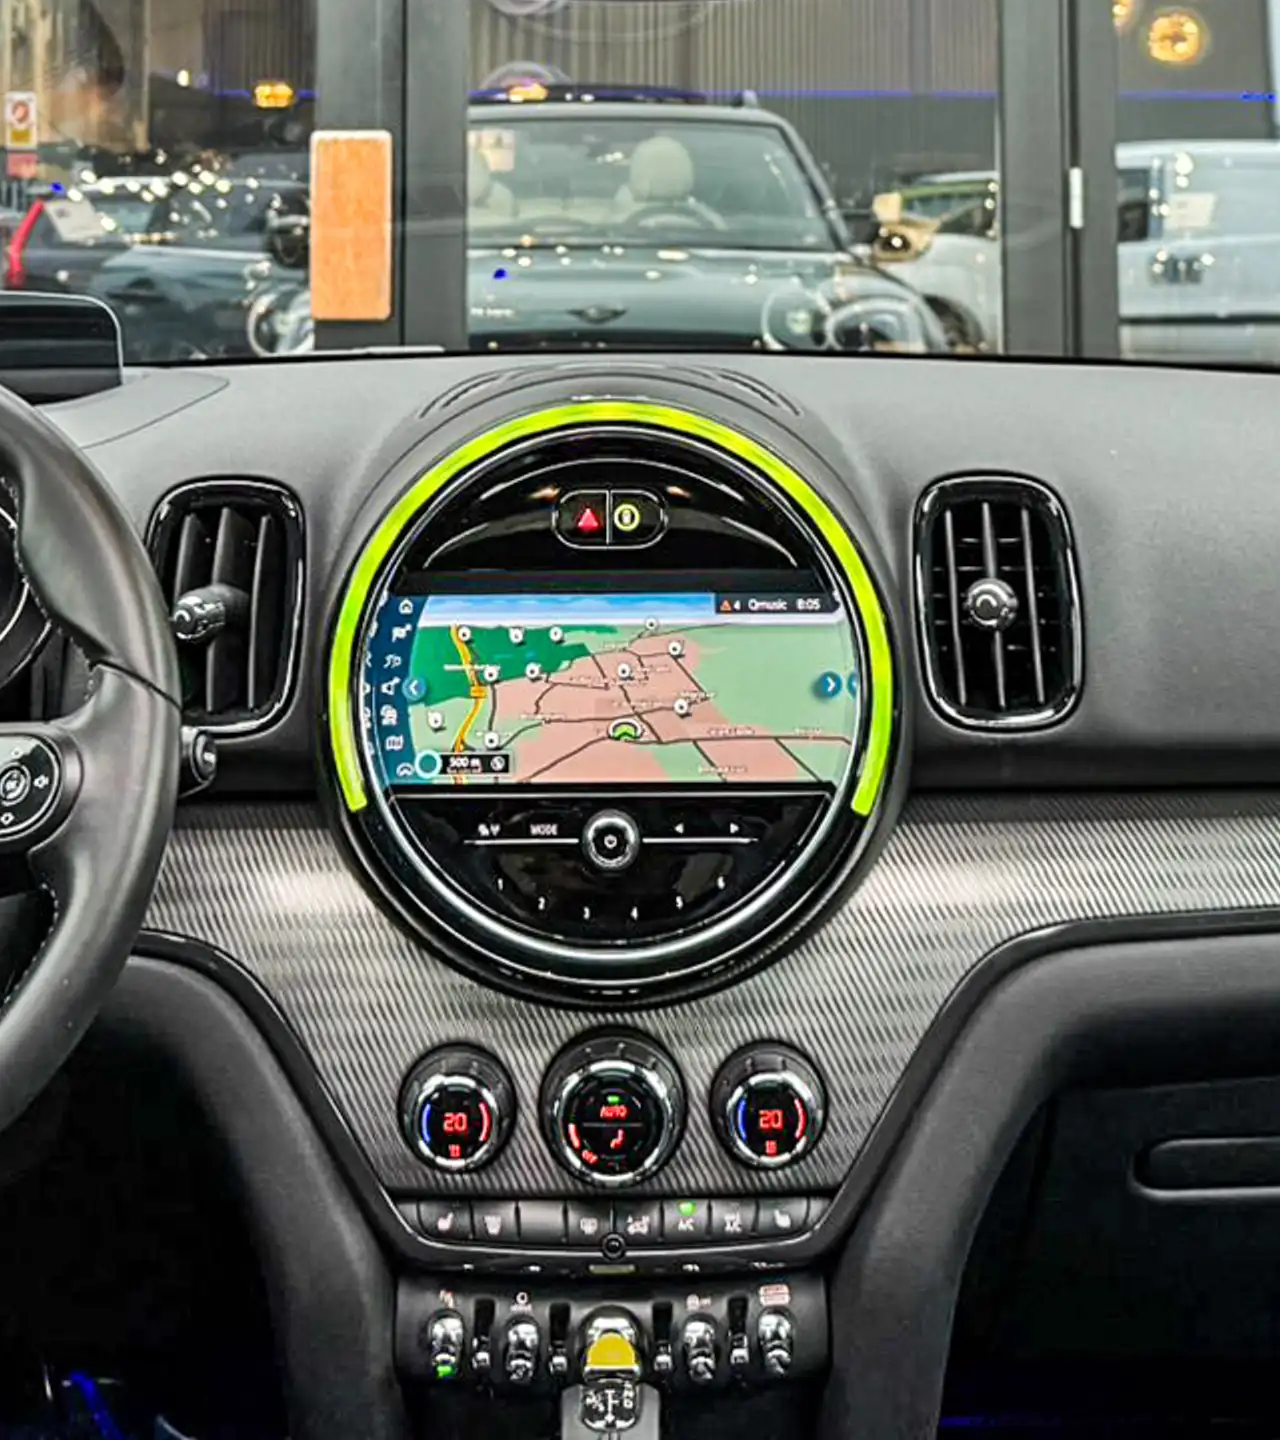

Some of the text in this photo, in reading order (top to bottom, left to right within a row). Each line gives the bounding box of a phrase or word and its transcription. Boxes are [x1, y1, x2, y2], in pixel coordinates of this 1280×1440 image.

[748, 598, 787, 611] Qmusic
[443, 1112, 468, 1132] 20
[759, 1110, 784, 1129] 20
